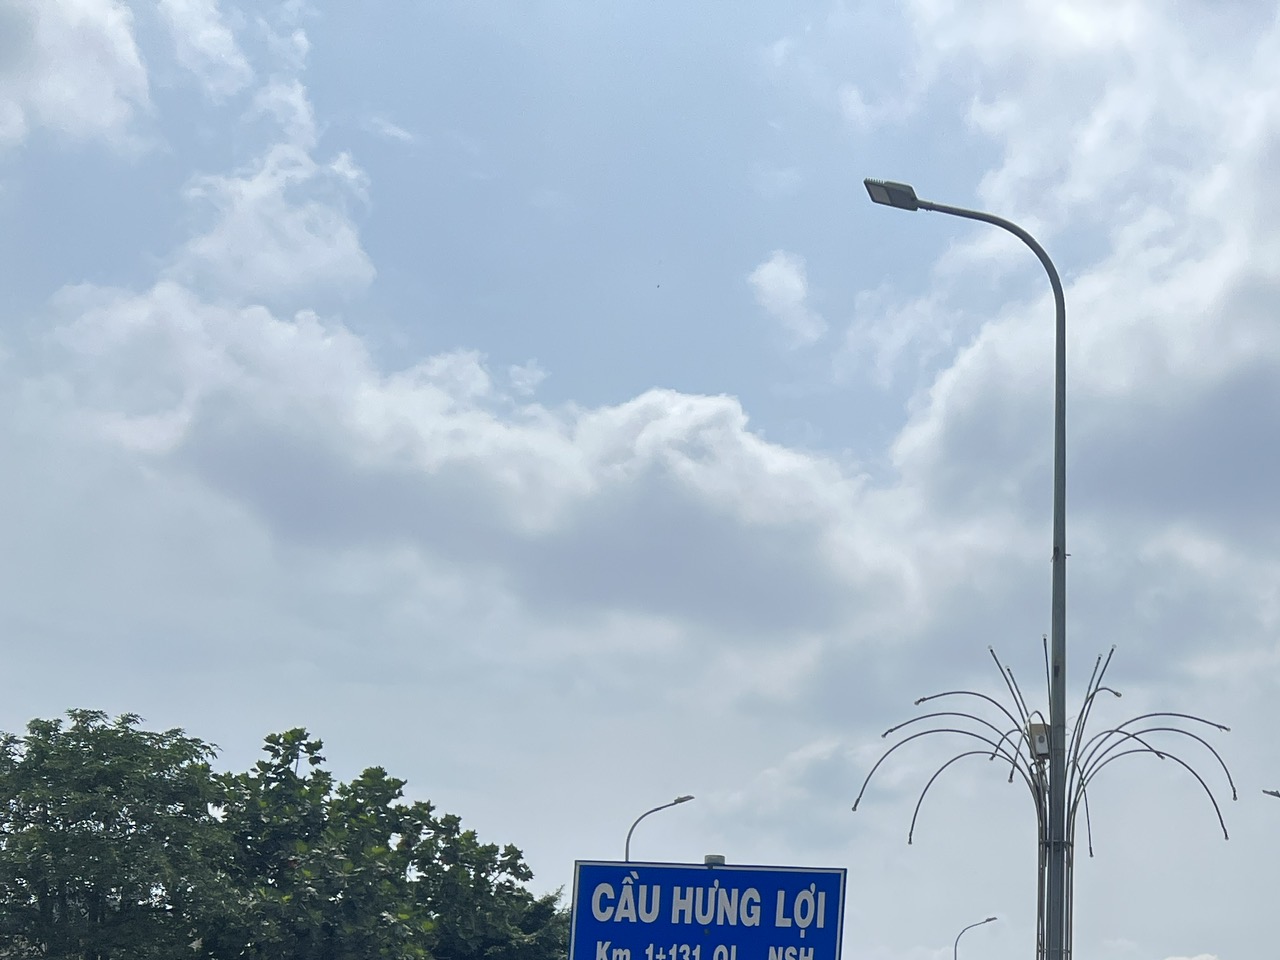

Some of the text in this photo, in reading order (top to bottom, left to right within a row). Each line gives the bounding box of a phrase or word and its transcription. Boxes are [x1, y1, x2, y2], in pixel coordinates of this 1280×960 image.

[591, 870, 826, 939] CẦU HƯNG LỢI
